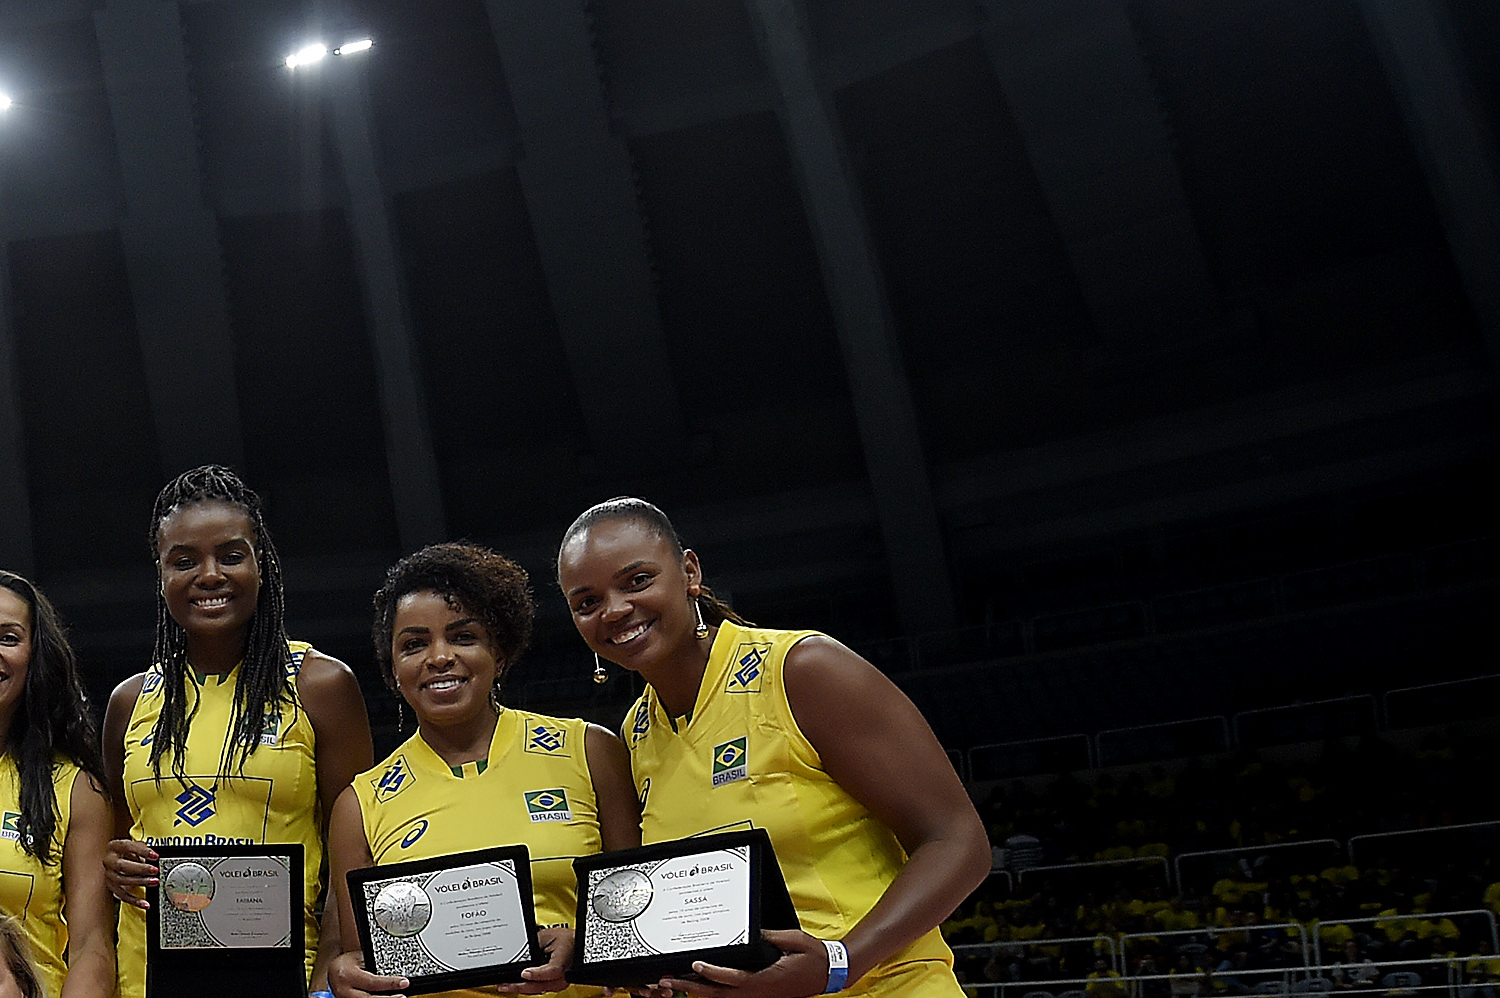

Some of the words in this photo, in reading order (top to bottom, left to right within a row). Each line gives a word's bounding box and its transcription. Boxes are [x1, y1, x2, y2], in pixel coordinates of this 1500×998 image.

[712, 768, 746, 786] BRASIL
[531, 812, 571, 822] BRASIL
[252, 868, 279, 878] BRASIL
[701, 862, 734, 875] BRASIL
[472, 876, 504, 888] BRASIL
